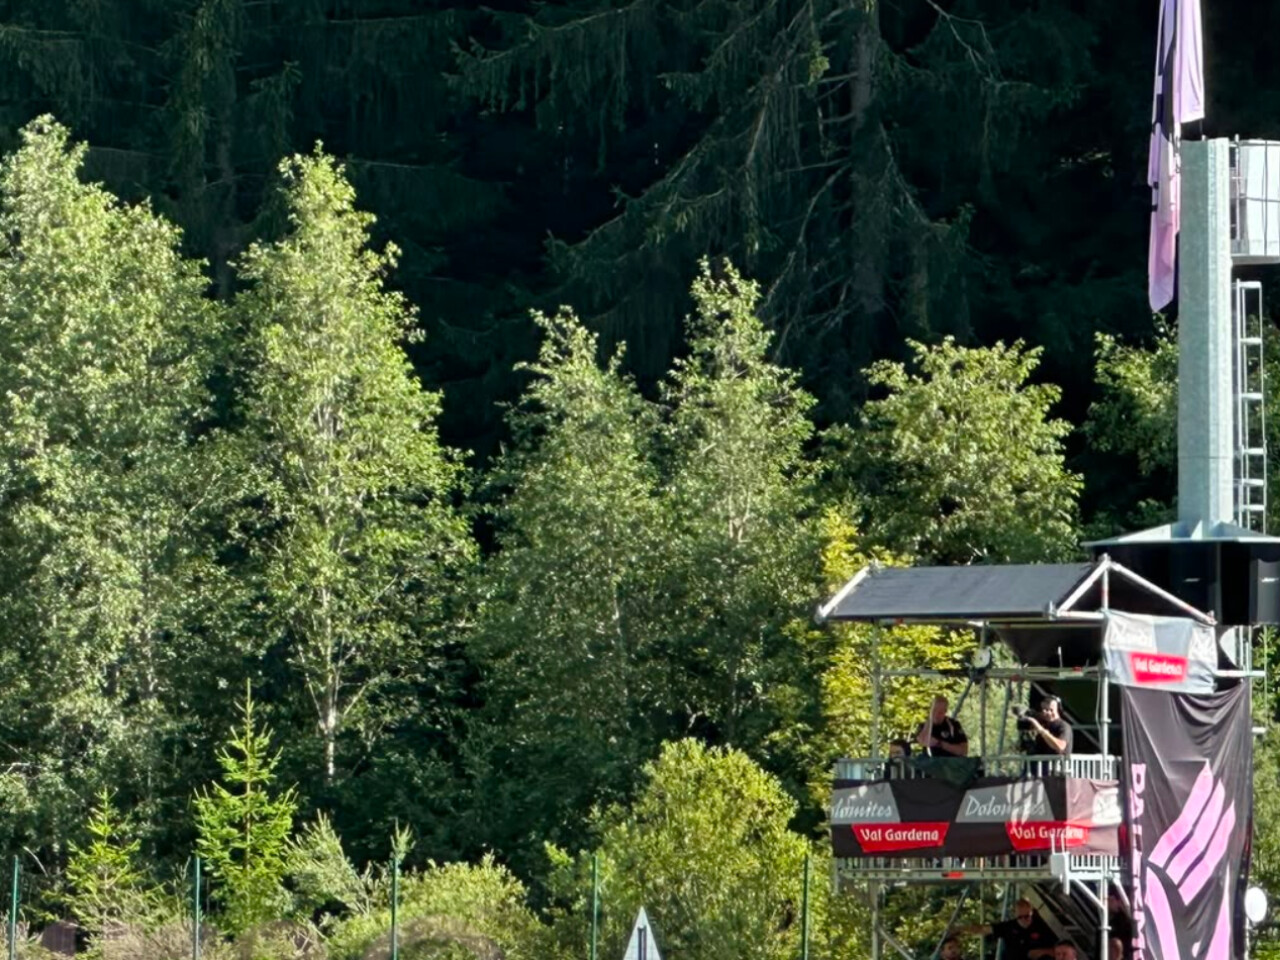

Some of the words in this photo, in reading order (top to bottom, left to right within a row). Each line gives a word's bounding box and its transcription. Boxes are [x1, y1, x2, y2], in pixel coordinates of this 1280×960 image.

[860, 828, 882, 841] Val
[885, 828, 939, 841] Gardena
[1011, 826, 1035, 839] Val
